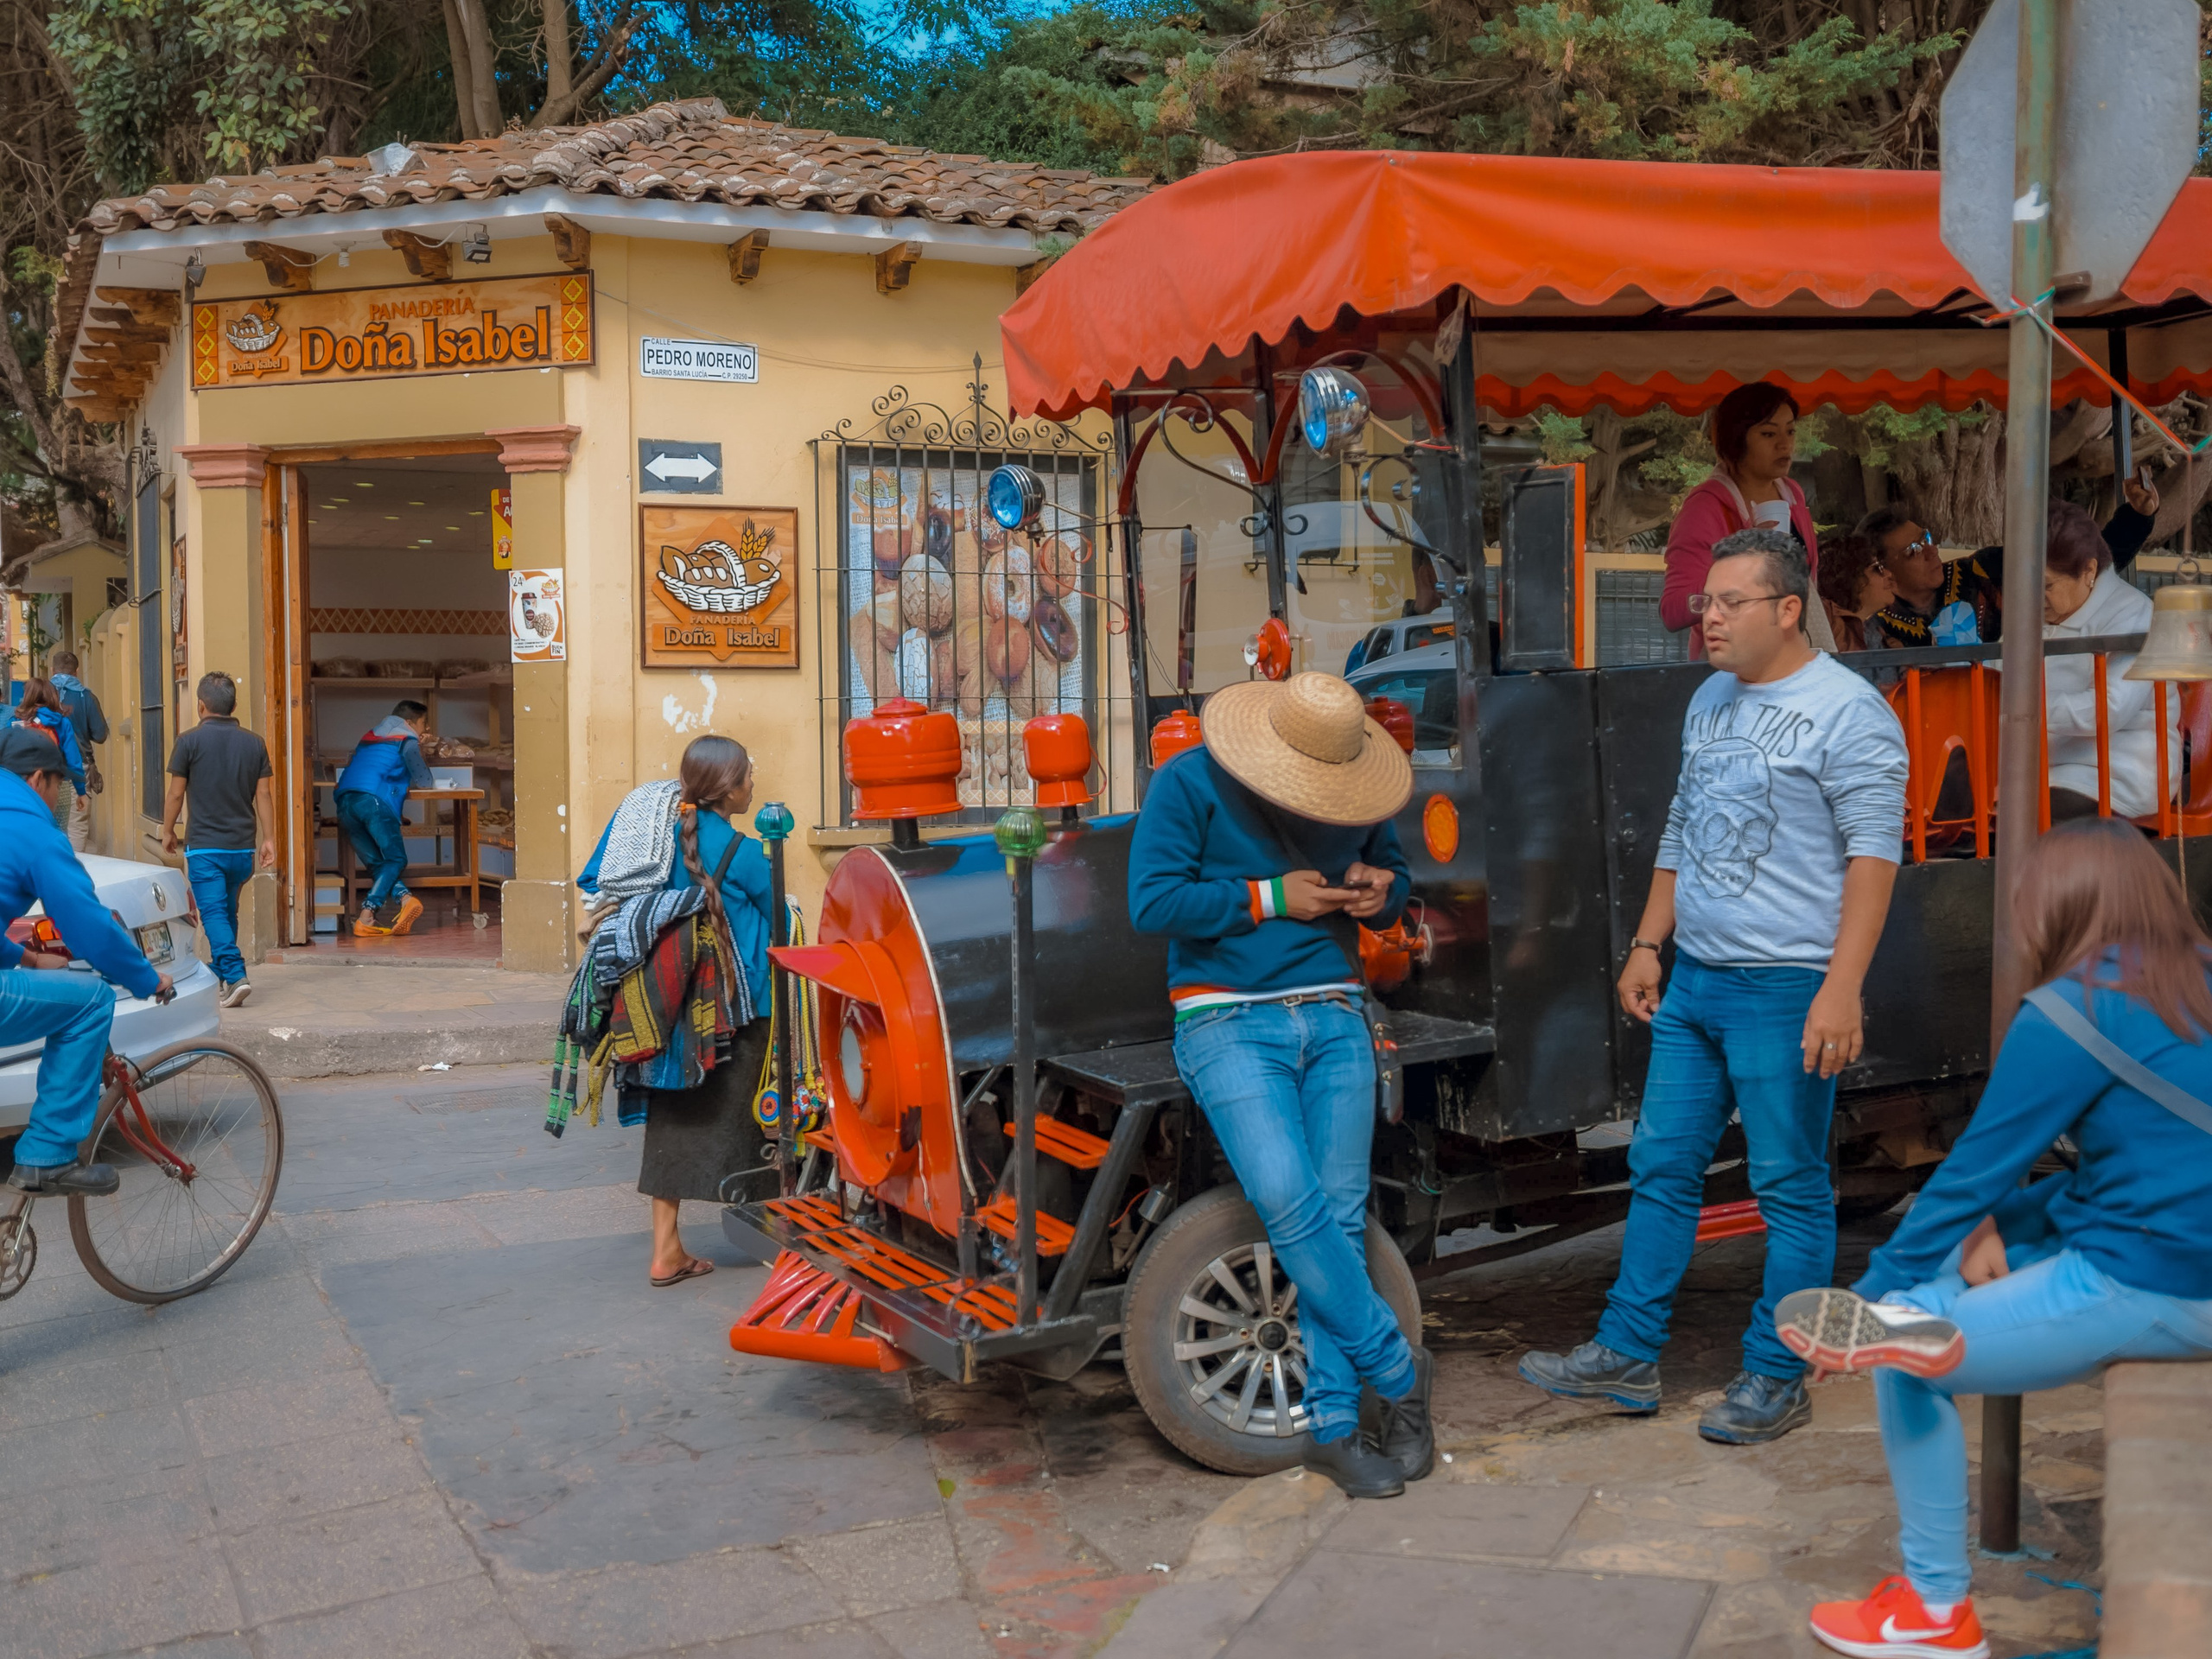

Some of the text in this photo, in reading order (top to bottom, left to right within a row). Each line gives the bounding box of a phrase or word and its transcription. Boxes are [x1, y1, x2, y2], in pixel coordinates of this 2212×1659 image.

[369, 288, 474, 321] PANADERÍA
[300, 304, 552, 375] Doña Isabel
[232, 358, 281, 372] Doña Isabel
[647, 348, 752, 370] PEDRO MORENO
[651, 368, 672, 377] BARRIO
[673, 369, 691, 378] SANTA
[691, 370, 708, 378] LUCÍA
[690, 612, 756, 626] PANADERÍA
[664, 626, 780, 647] Doña Isabel
[1747, 702, 1814, 758] THIS
[1697, 751, 1760, 784] SHIT
